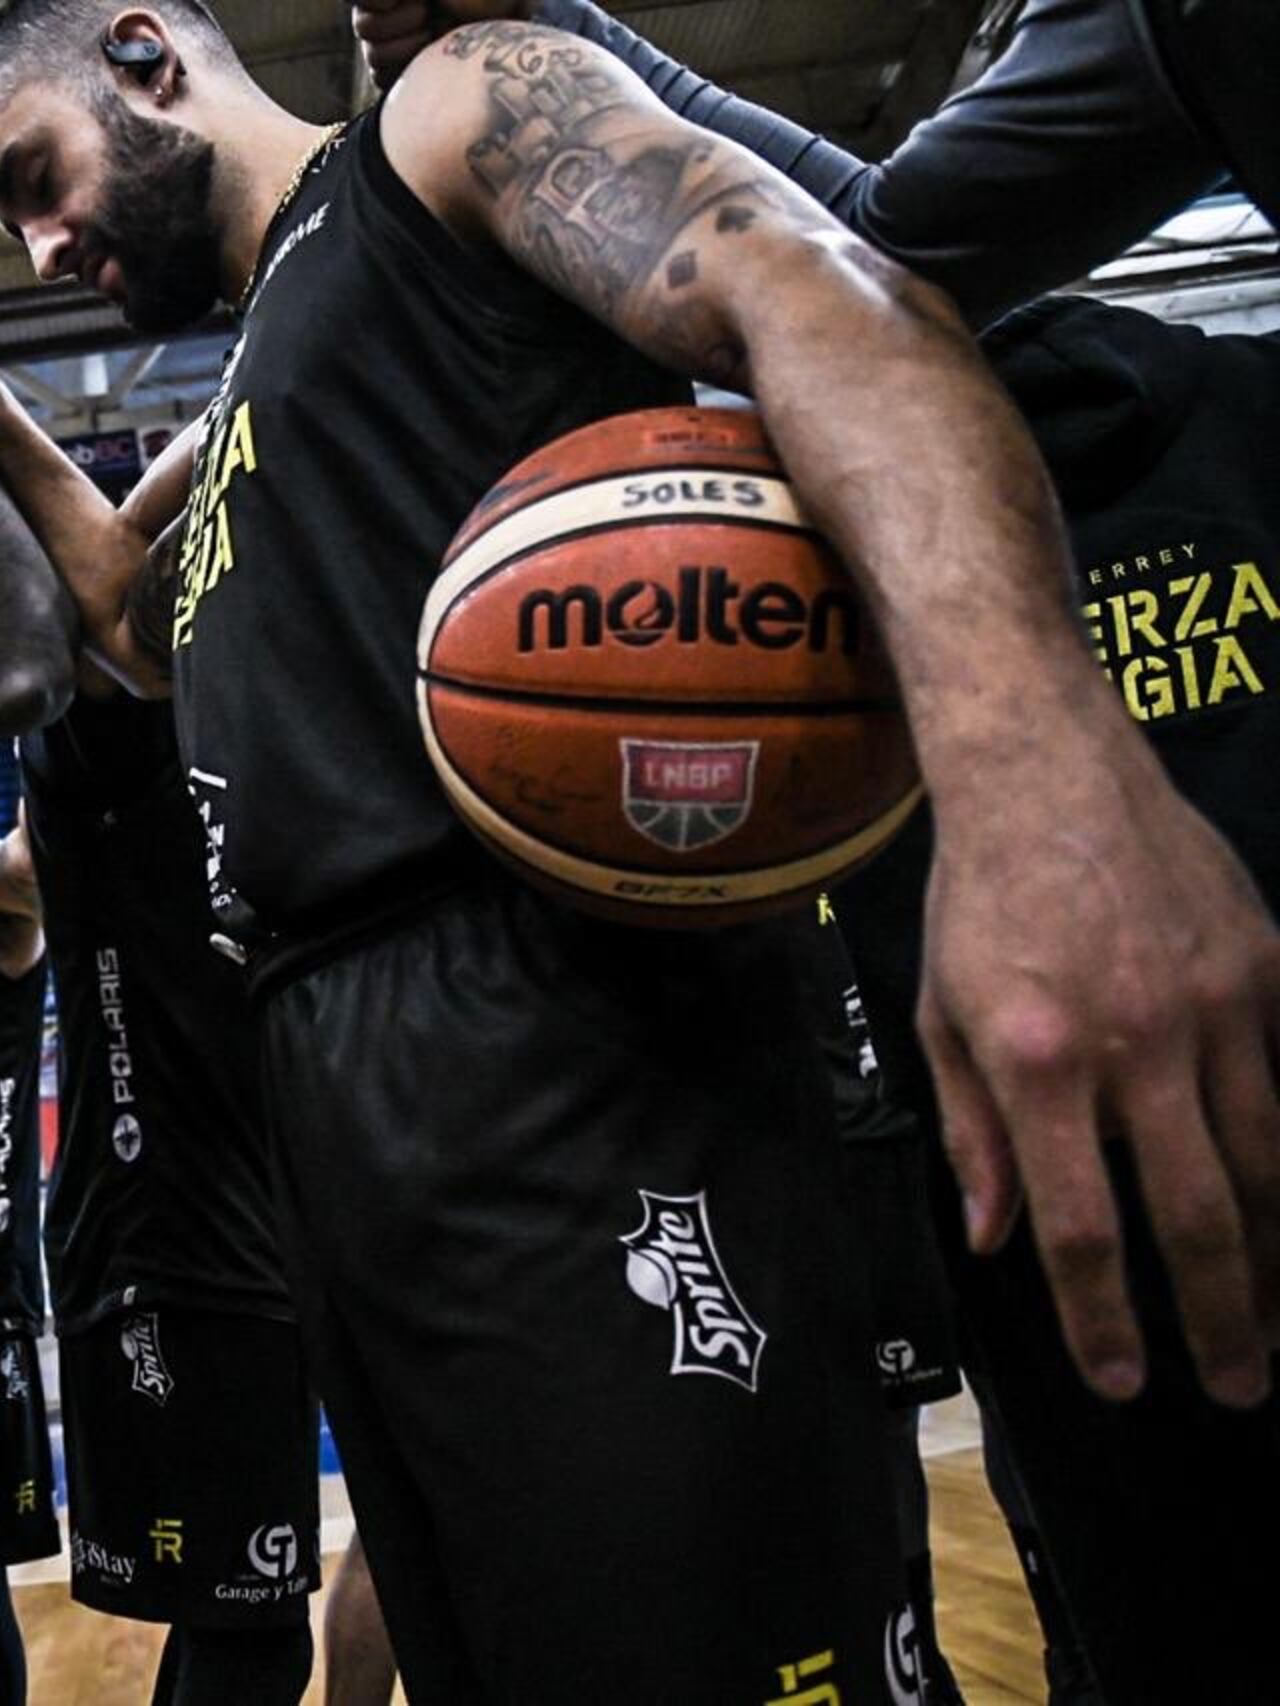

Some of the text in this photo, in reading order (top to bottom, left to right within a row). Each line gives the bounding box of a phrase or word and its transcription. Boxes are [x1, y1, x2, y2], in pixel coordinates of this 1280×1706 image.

[1089, 543, 1197, 585] ERREY
[517, 566, 861, 655] molten
[1080, 562, 1280, 662] ERZA
[1112, 636, 1265, 721] GIA
[644, 763, 729, 791] LNBP
[96, 947, 136, 1105] POLARIS
[649, 1208, 752, 1368] Sprite
[215, 1584, 270, 1603] Garage
